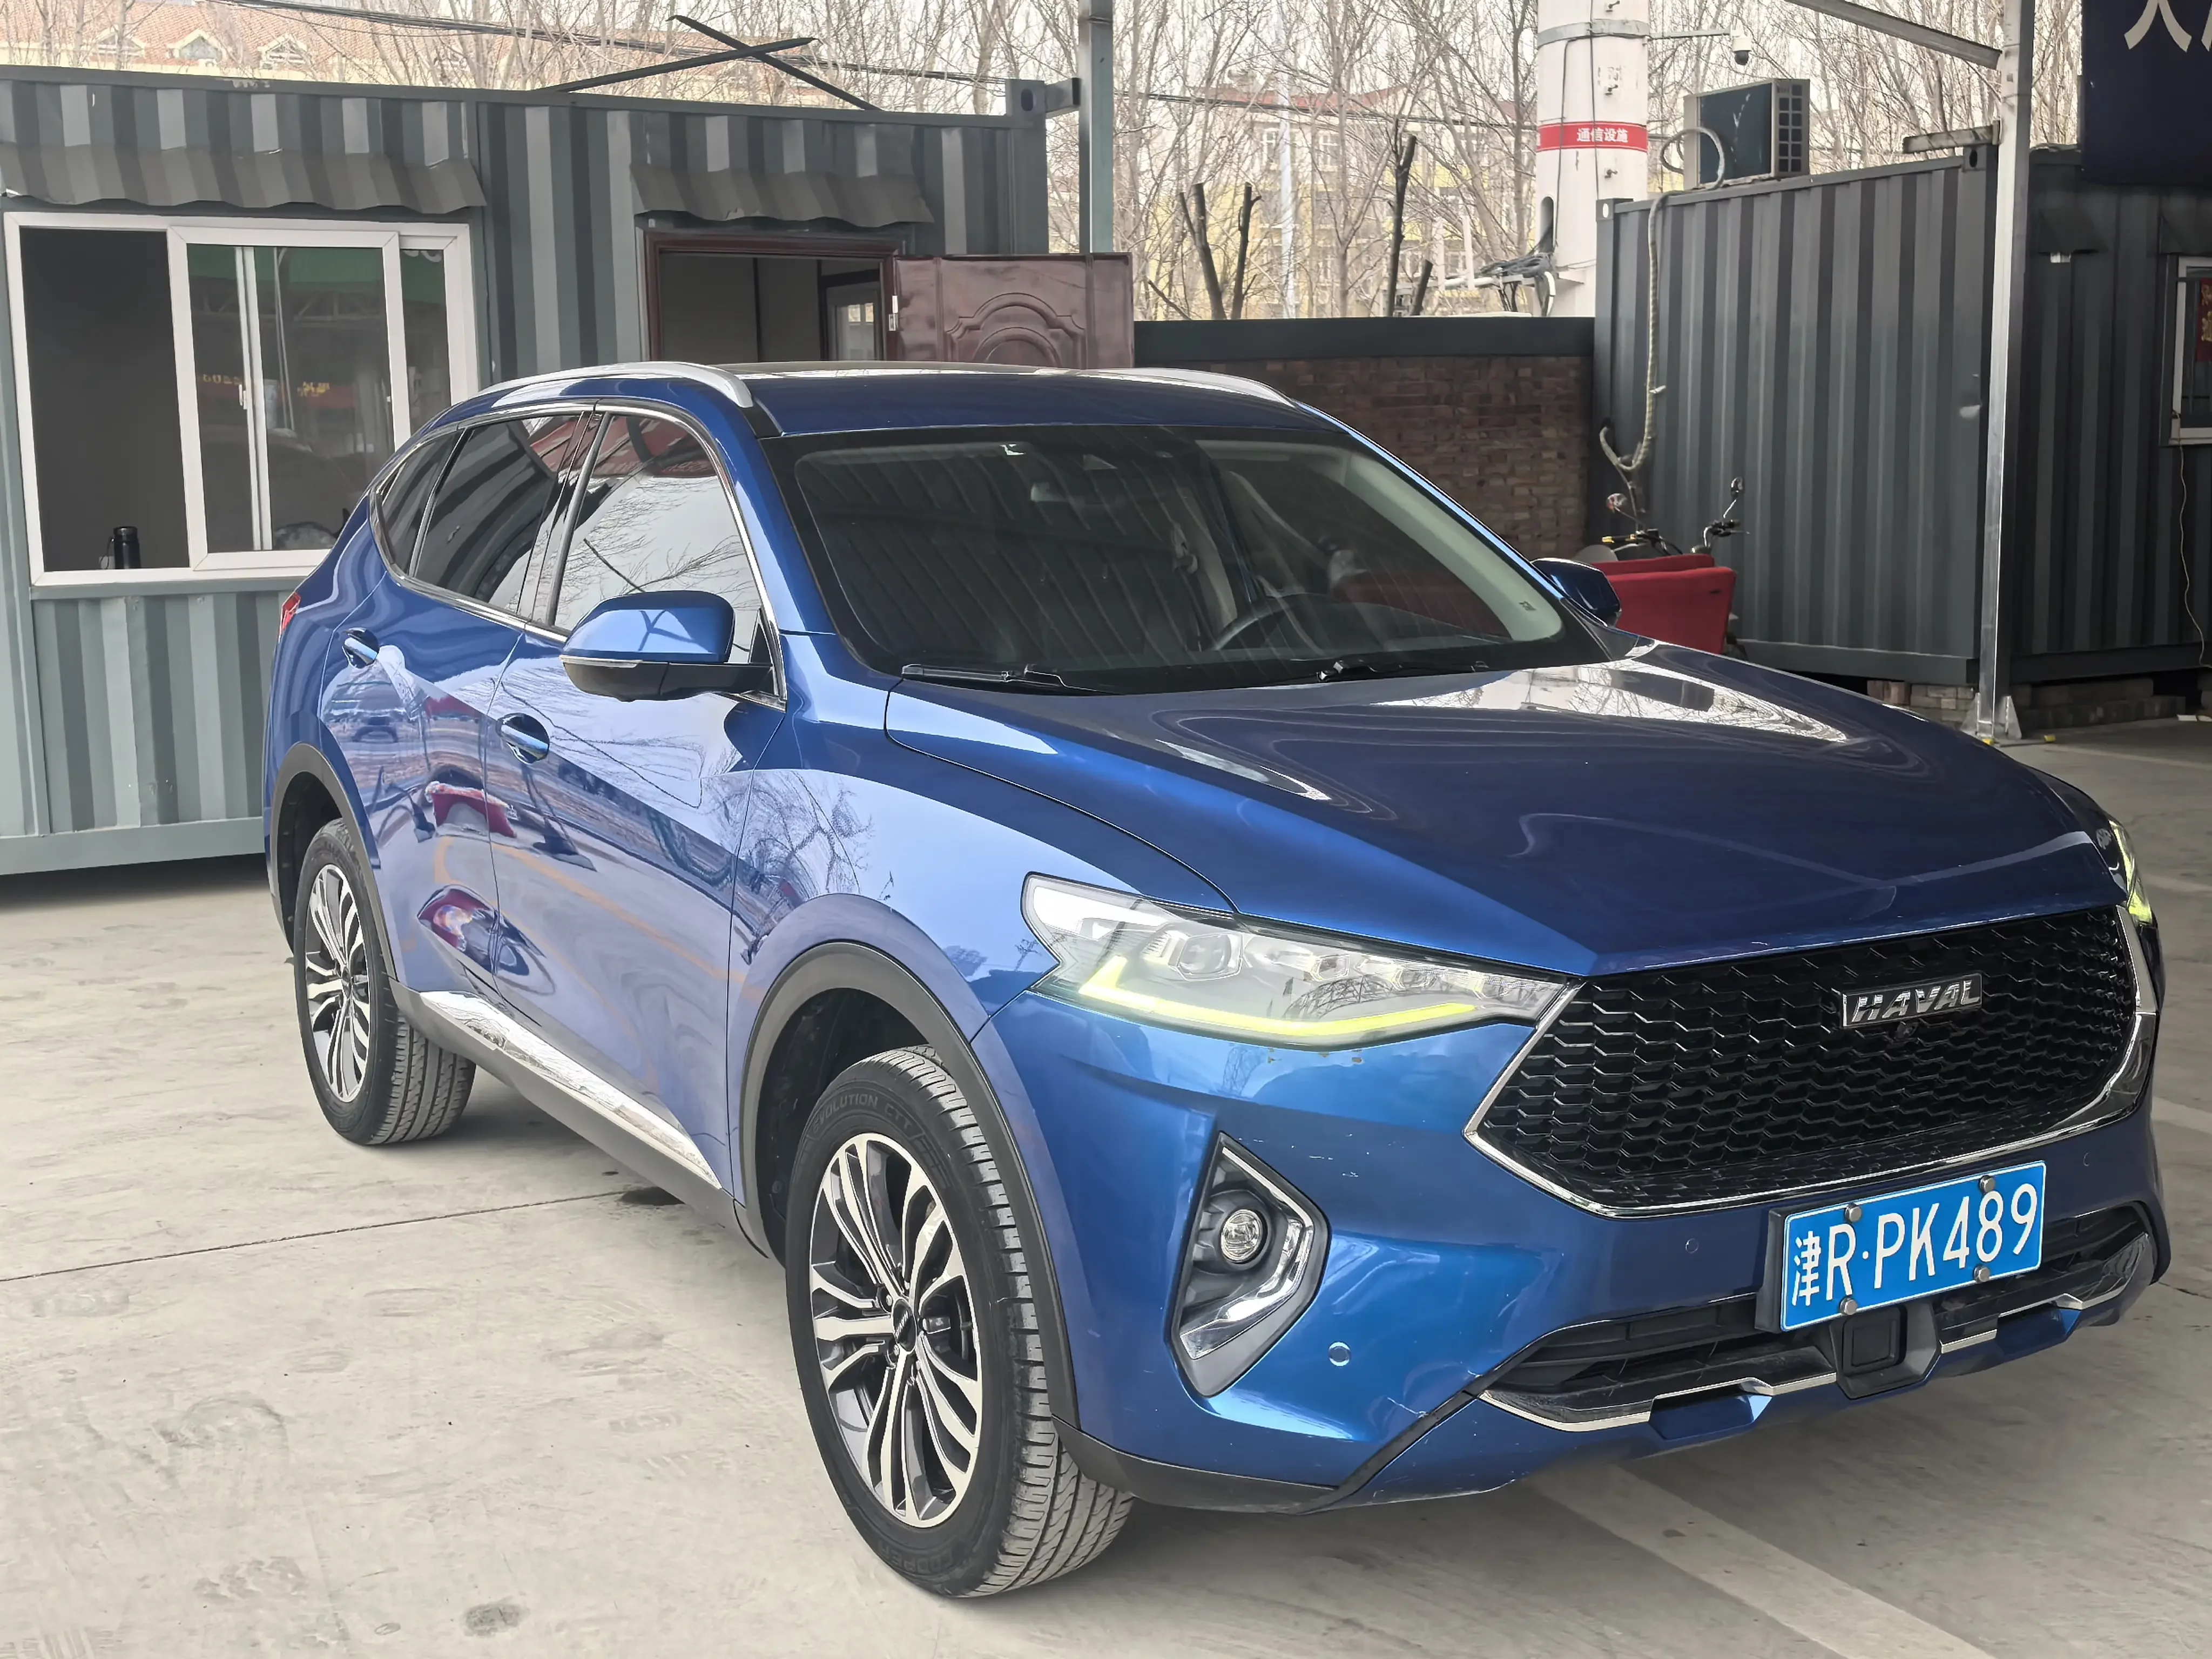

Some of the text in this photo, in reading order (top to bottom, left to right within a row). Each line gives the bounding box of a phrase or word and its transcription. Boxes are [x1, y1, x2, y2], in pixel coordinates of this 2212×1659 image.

[1577, 127, 1629, 143] 通信设施
[1852, 980, 1981, 1022] HAVAL
[813, 1093, 913, 1132] EVOLUTION CTT
